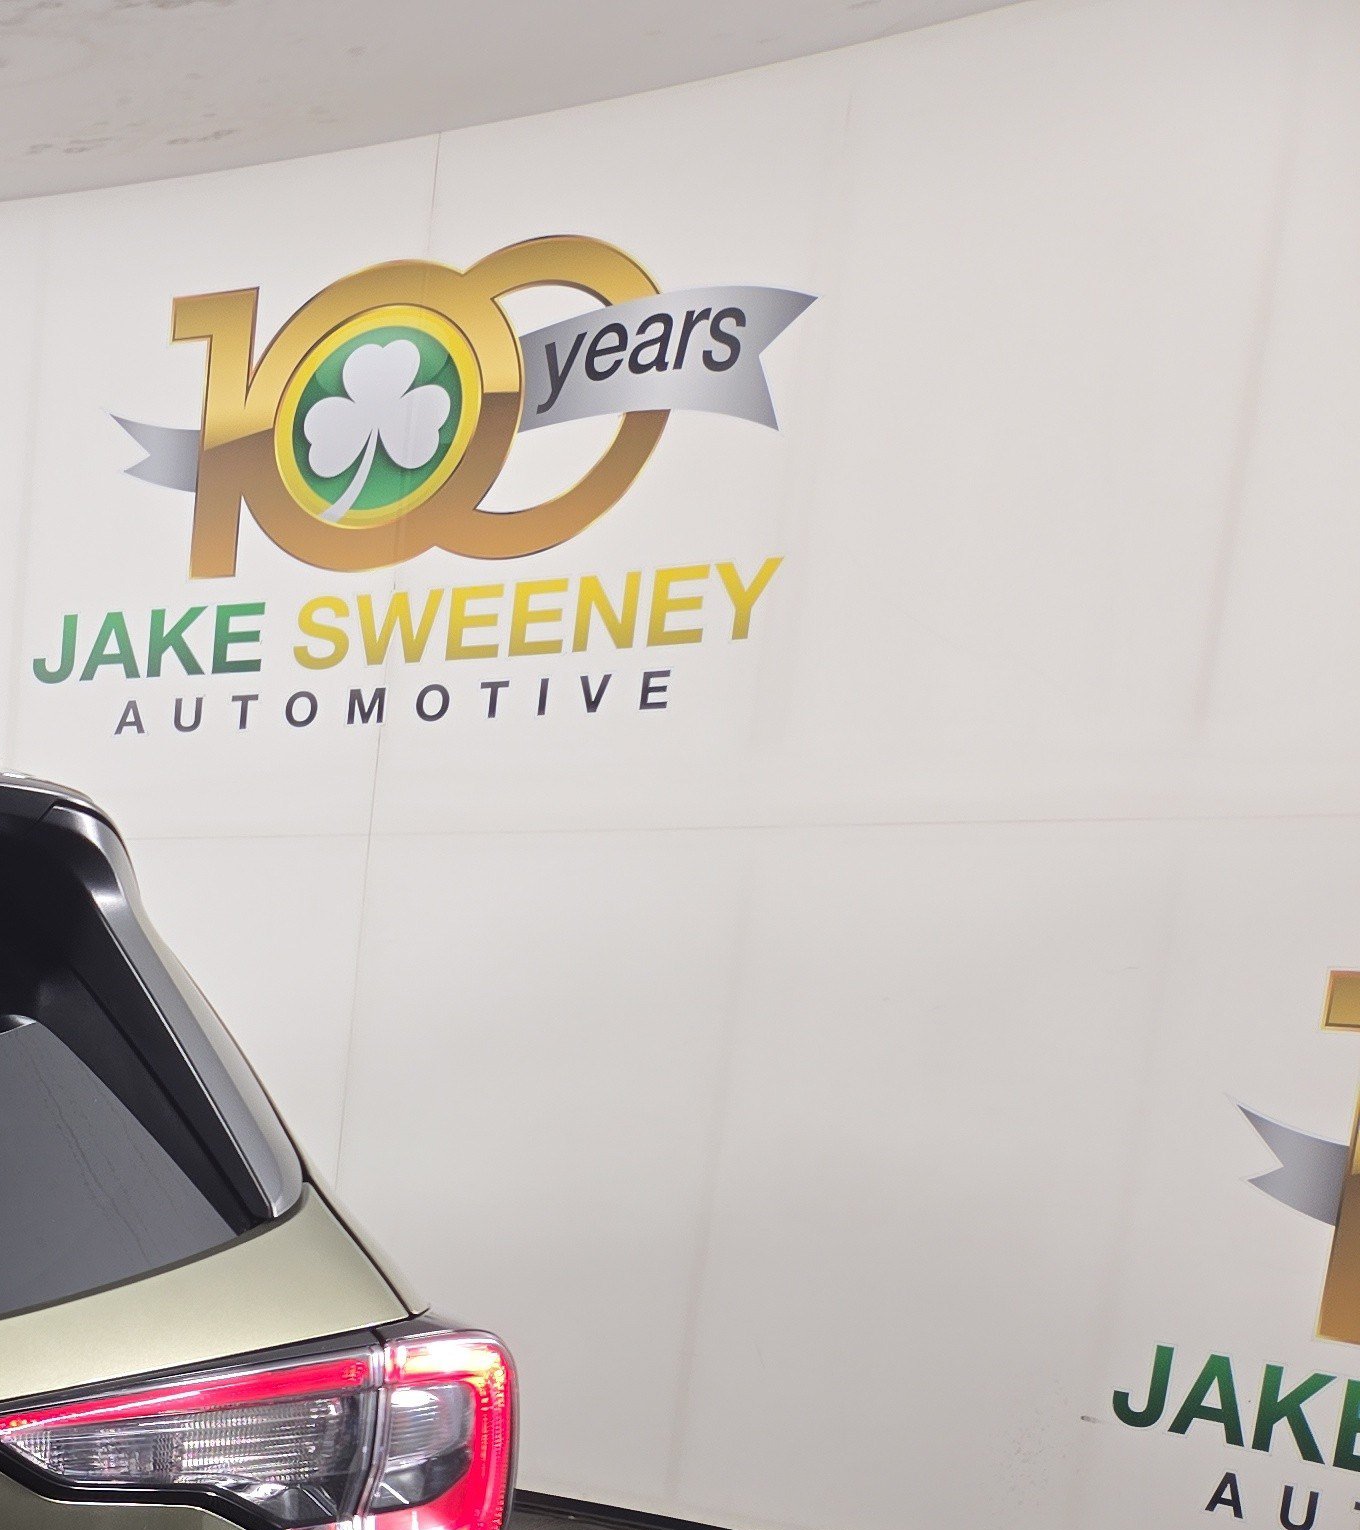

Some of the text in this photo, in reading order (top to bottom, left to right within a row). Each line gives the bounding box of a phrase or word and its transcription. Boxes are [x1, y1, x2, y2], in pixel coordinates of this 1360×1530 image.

[172, 234, 747, 580] 100 years
[32, 556, 784, 685] JAKE SWEENEY
[114, 669, 672, 736] AUTOMOTIVE
